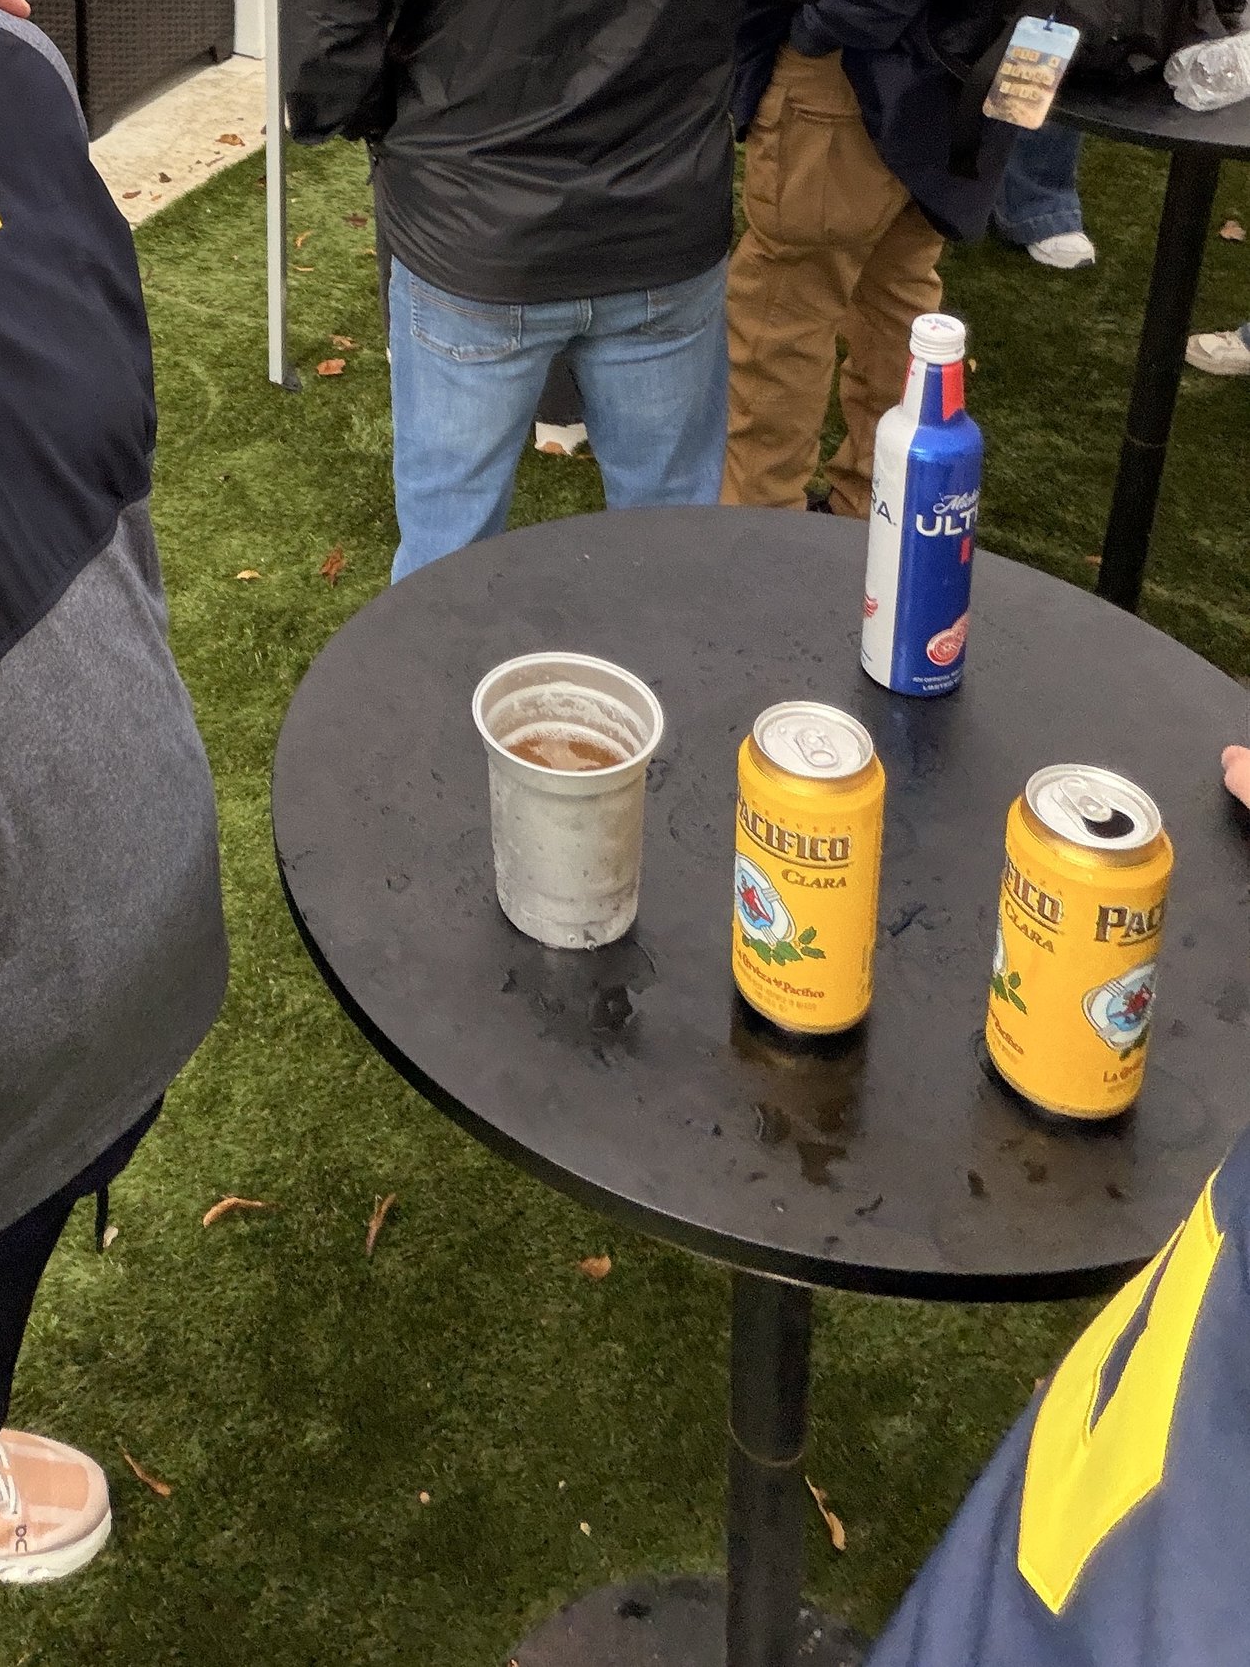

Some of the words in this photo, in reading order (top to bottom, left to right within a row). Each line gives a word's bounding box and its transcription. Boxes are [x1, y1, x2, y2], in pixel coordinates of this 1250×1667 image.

[738, 787, 853, 863] ACIFICO
[781, 868, 848, 890] CLARA
[1004, 899, 1054, 953] CLARA
